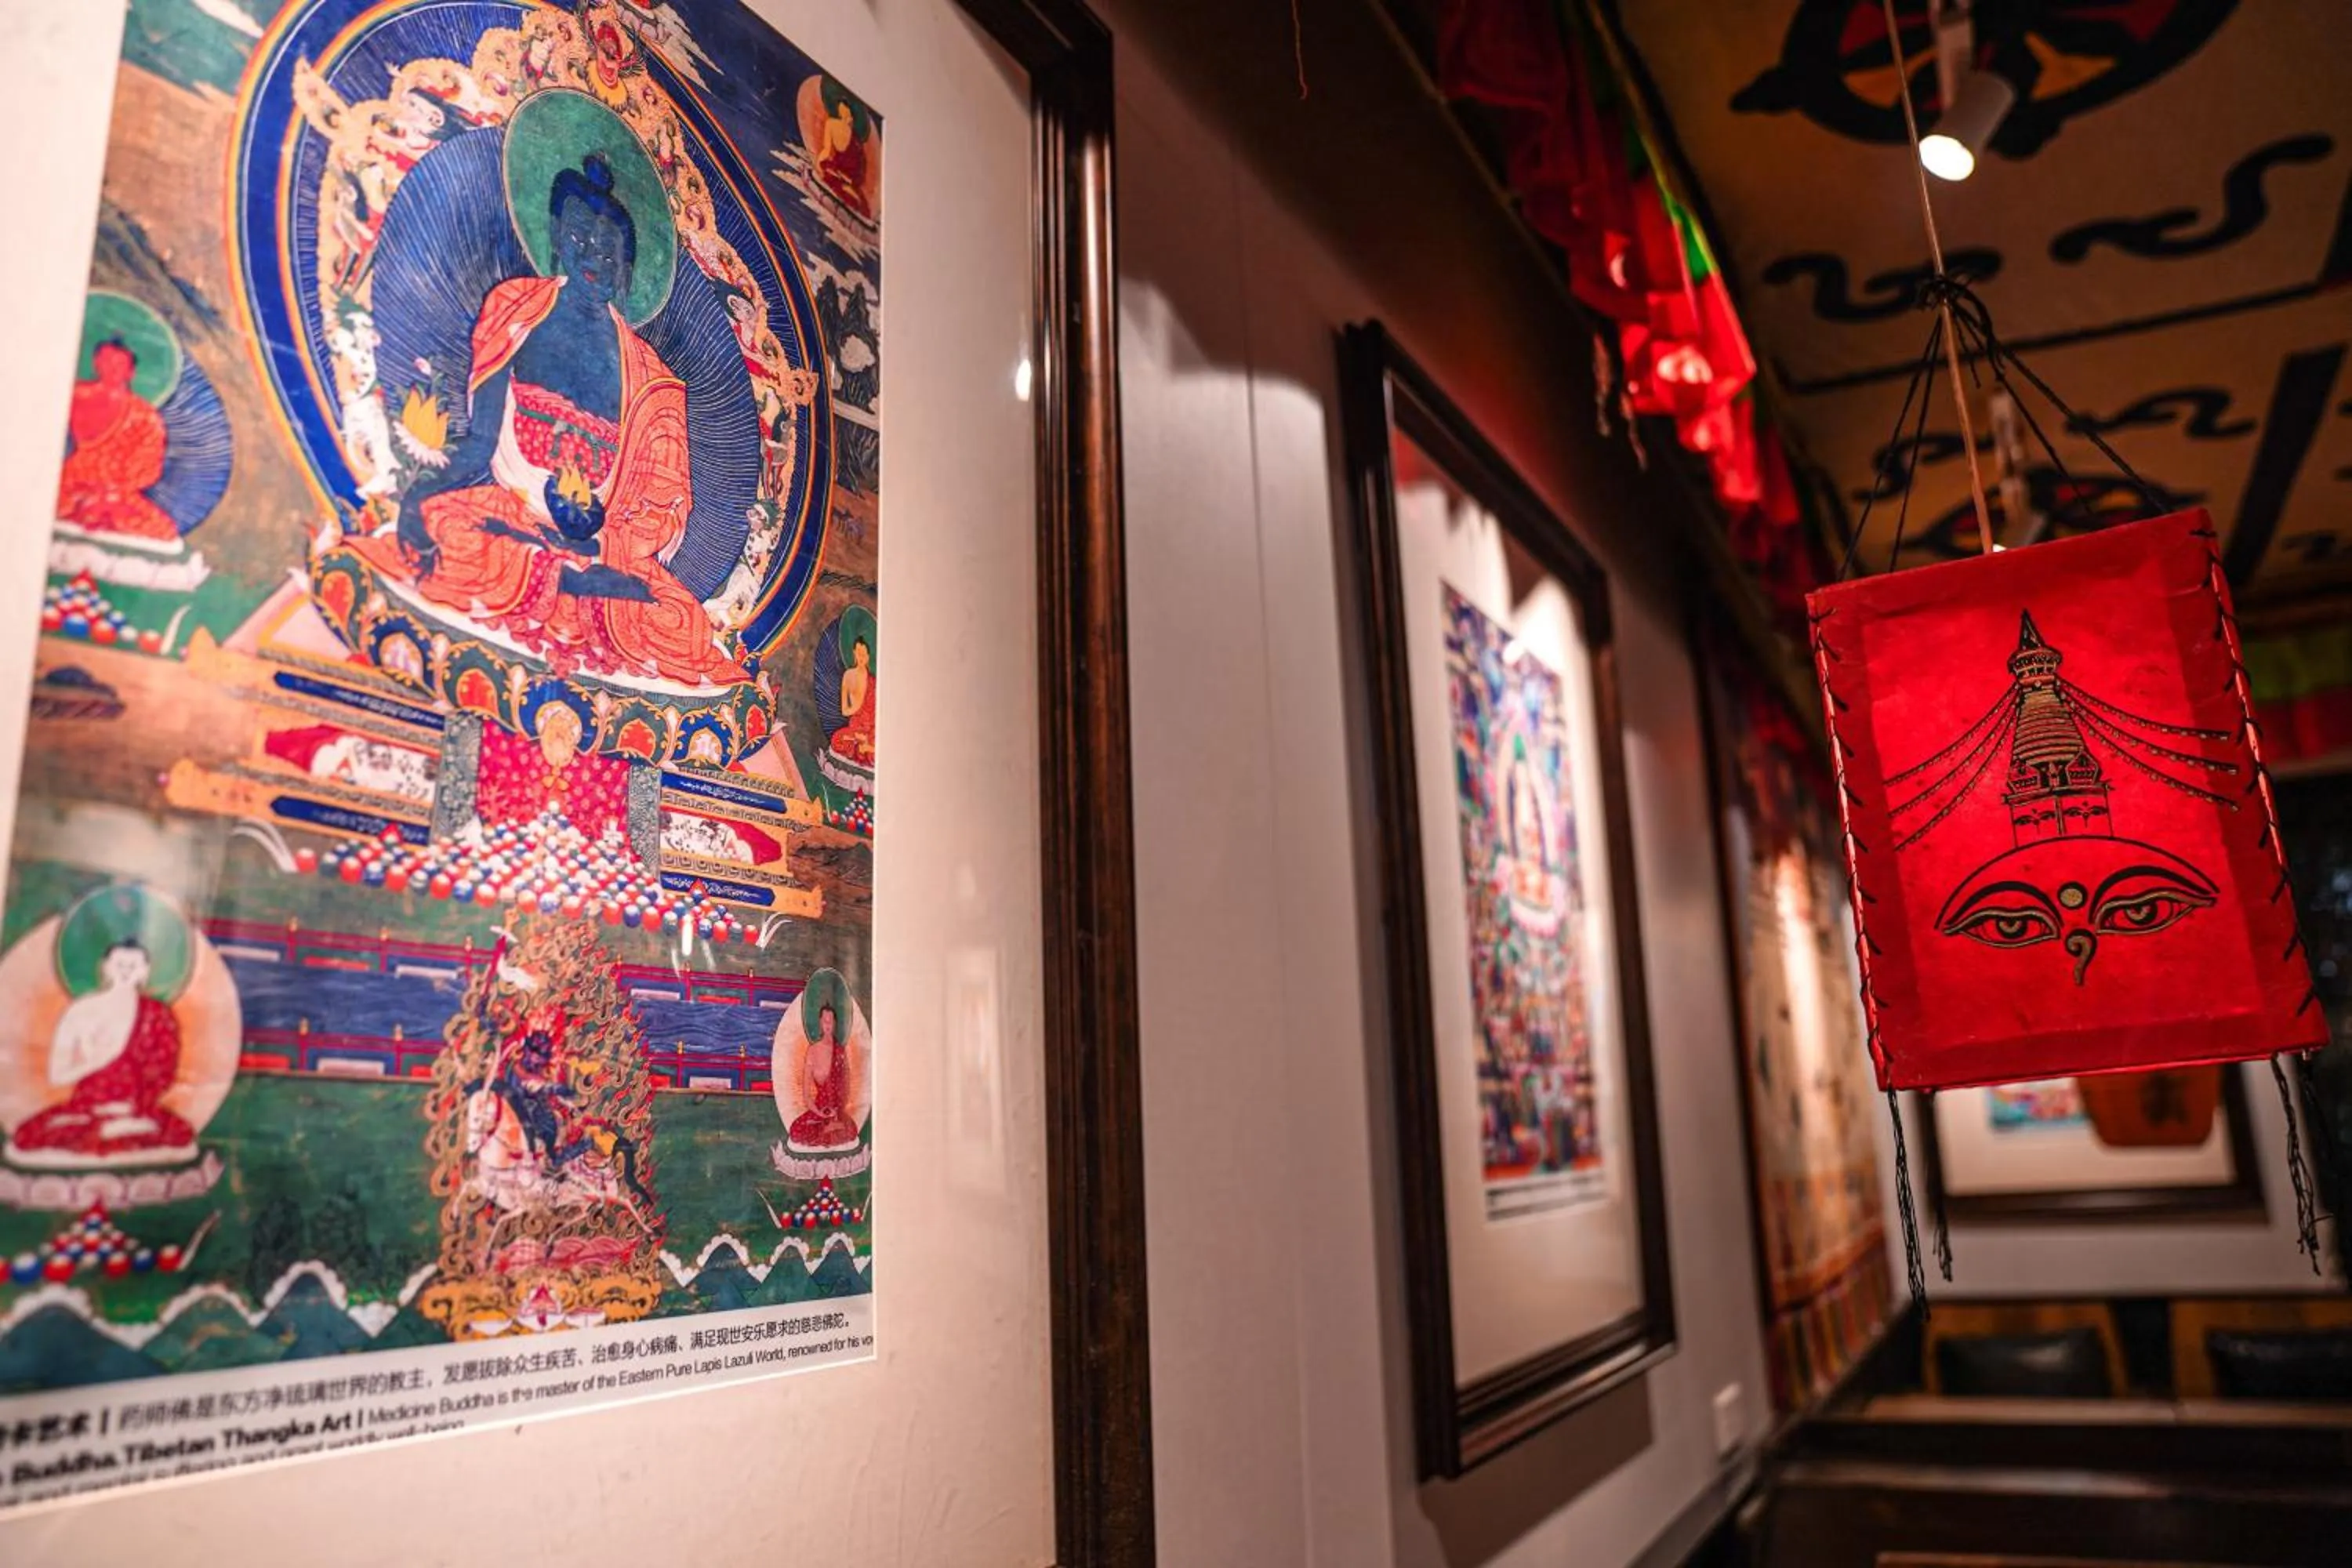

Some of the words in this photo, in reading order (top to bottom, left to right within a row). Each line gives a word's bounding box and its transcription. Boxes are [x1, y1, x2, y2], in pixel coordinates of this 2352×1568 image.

[122, 1436, 215, 1465] Tibetan
[222, 1417, 315, 1449] Thangka
[319, 1410, 351, 1433] Art
[368, 1402, 437, 1425] Medicine
[439, 1392, 495, 1415] Buddha
[497, 1392, 509, 1405] is
[510, 1386, 534, 1403] the
[535, 1380, 581, 1399] master
[583, 1374, 595, 1392] of
[597, 1374, 618, 1389] the
[618, 1367, 664, 1386] Eastern
[666, 1363, 692, 1378] Pure
[694, 1356, 722, 1375] Lapis
[724, 1348, 753, 1369] Lazuli
[755, 1347, 786, 1363] World,
[787, 1338, 833, 1359] renowned
[833, 1337, 846, 1351] for
[847, 1335, 860, 1348] his
[862, 1334, 874, 1345] vo
